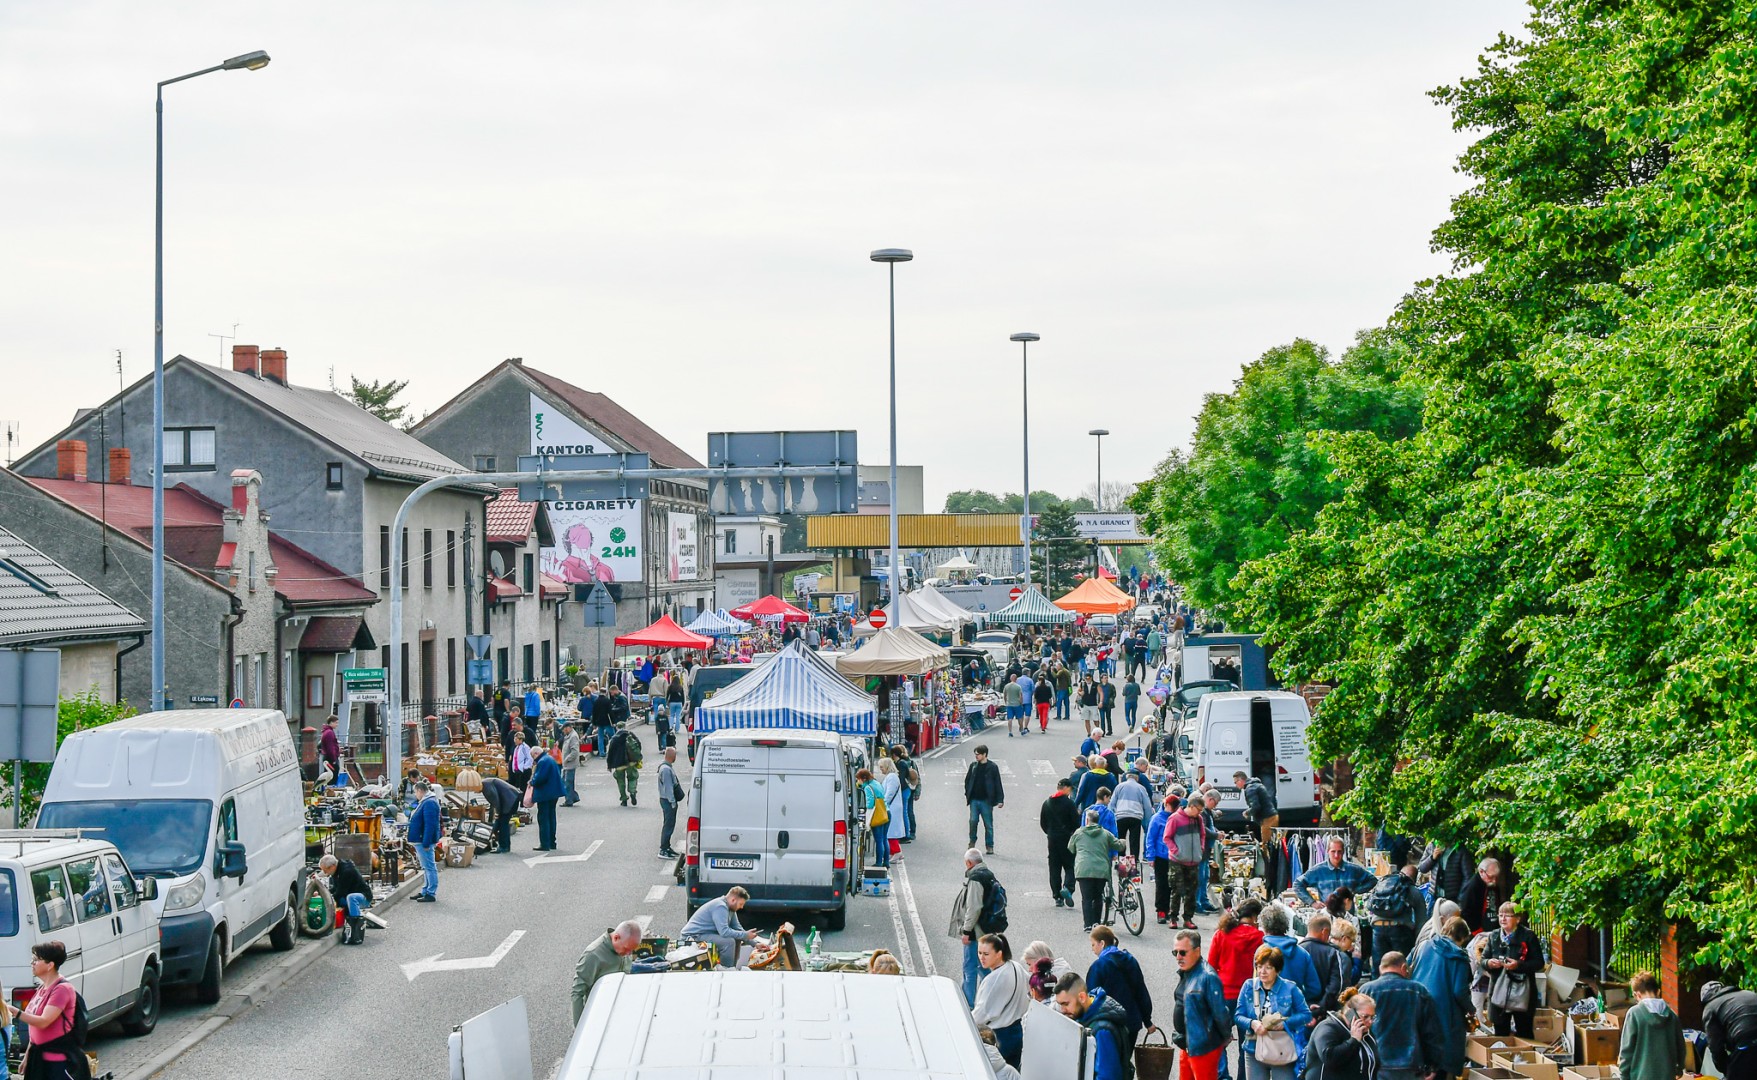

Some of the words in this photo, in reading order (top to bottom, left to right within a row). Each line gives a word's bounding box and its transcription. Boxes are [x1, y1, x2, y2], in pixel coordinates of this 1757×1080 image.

[536, 445, 594, 454] KANTOR
[554, 500, 637, 511] CIGARETY
[601, 546, 636, 558] 24H
[716, 859, 729, 867] TKN
[730, 859, 752, 868] 45527
